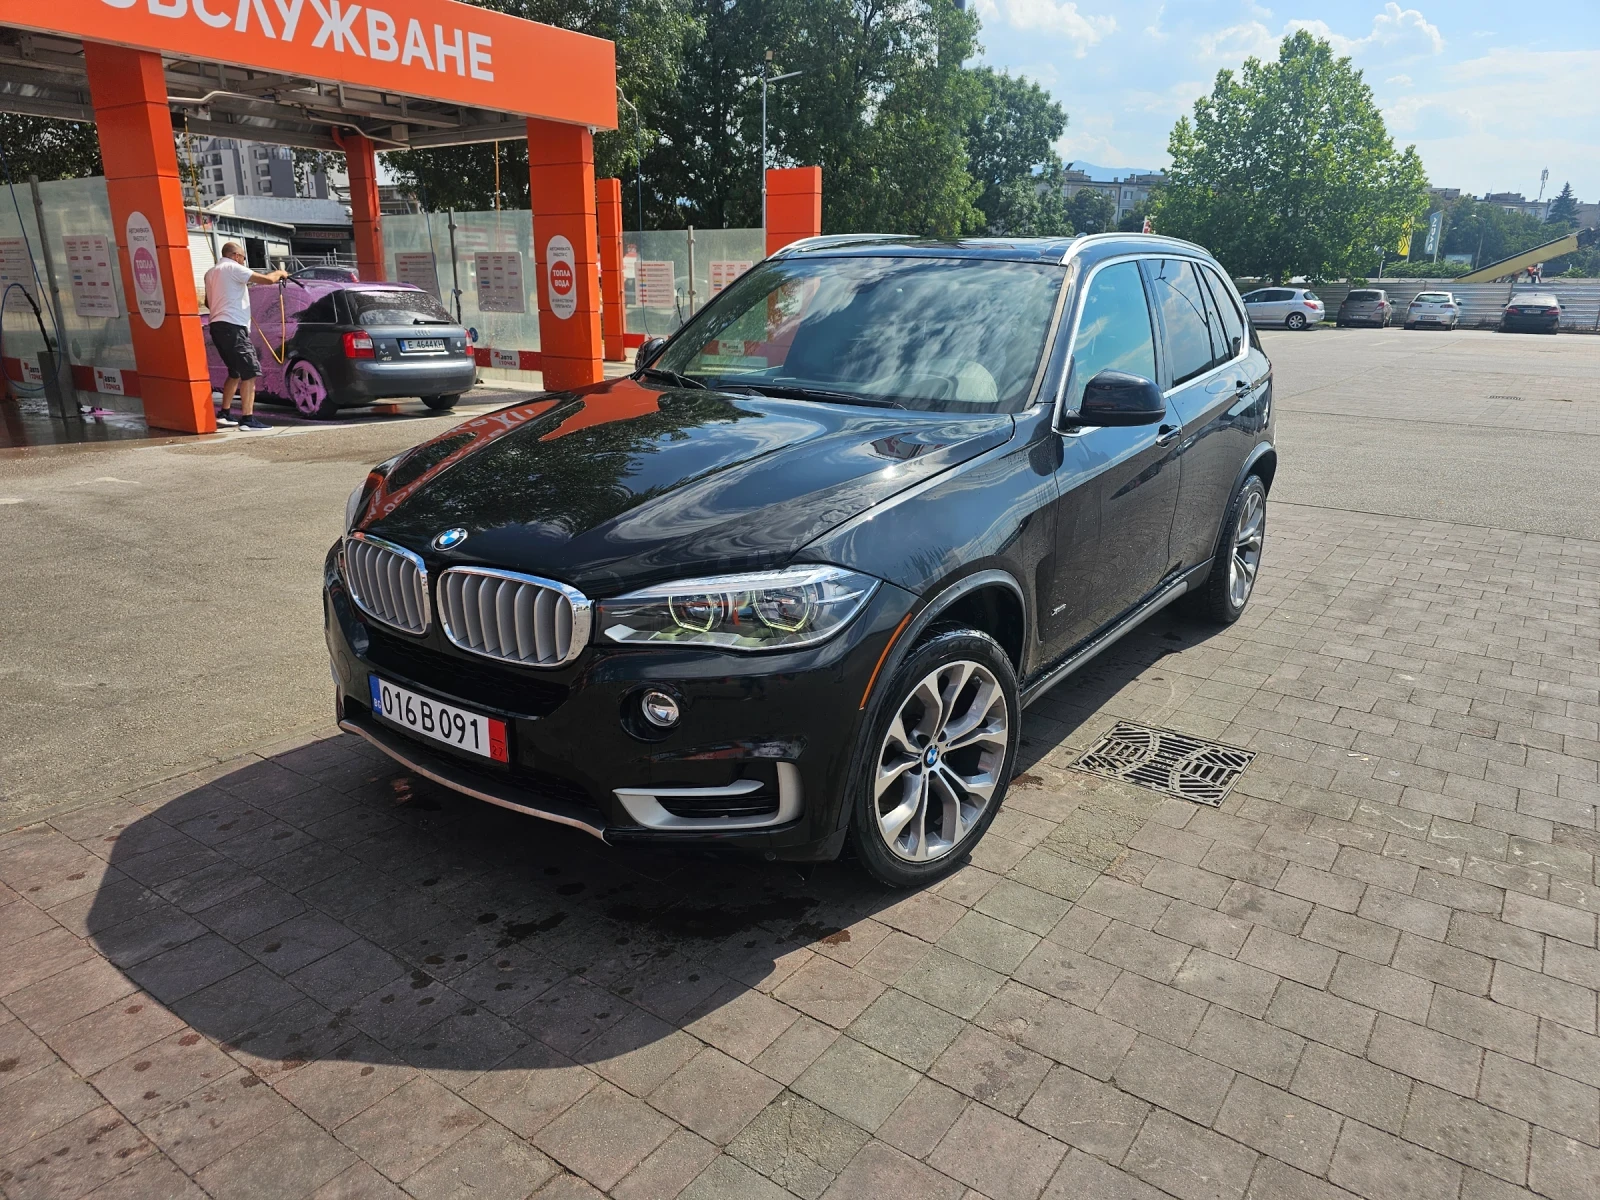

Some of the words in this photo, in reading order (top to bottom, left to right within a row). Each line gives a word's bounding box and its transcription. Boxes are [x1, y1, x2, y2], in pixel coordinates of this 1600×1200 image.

[407, 341, 414, 349] E
[373, 697, 382, 709] BG
[492, 745, 504, 757] 27
